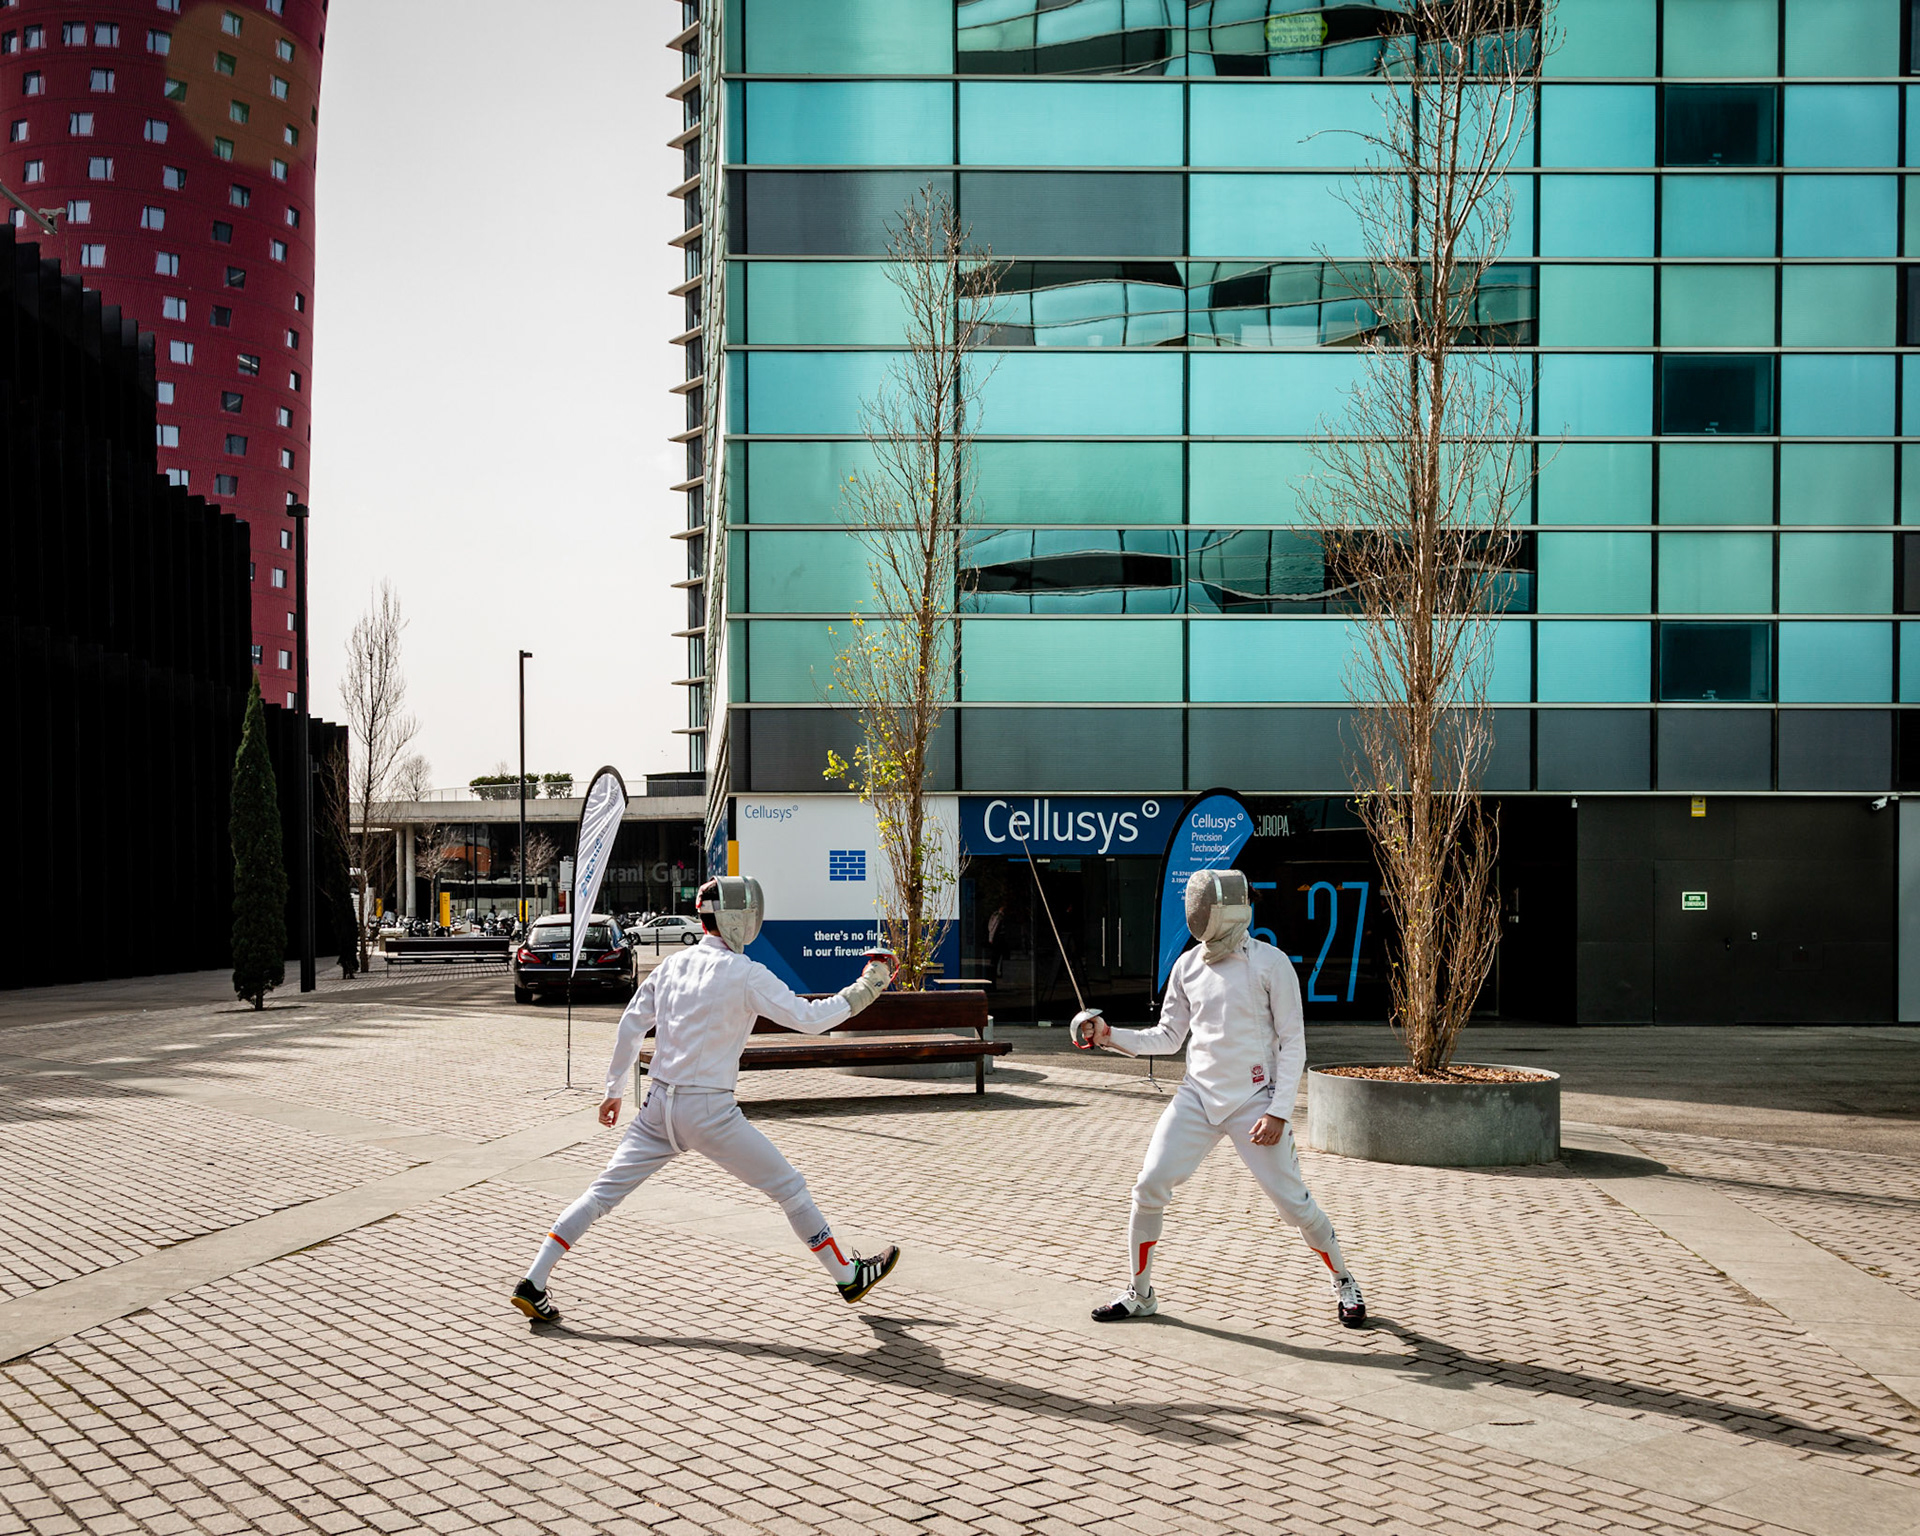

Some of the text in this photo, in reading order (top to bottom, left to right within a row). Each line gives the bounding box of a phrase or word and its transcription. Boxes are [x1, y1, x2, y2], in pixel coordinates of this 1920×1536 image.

[744, 804, 792, 823] Cellusys
[984, 799, 1139, 855] Cellusys
[1191, 813, 1236, 832] Cellusys
[1191, 832, 1222, 842] Precision
[1191, 843, 1229, 854] Technology
[814, 930, 849, 941] there's
[851, 933, 864, 941] no
[803, 946, 812, 957] in
[815, 948, 832, 957] our
